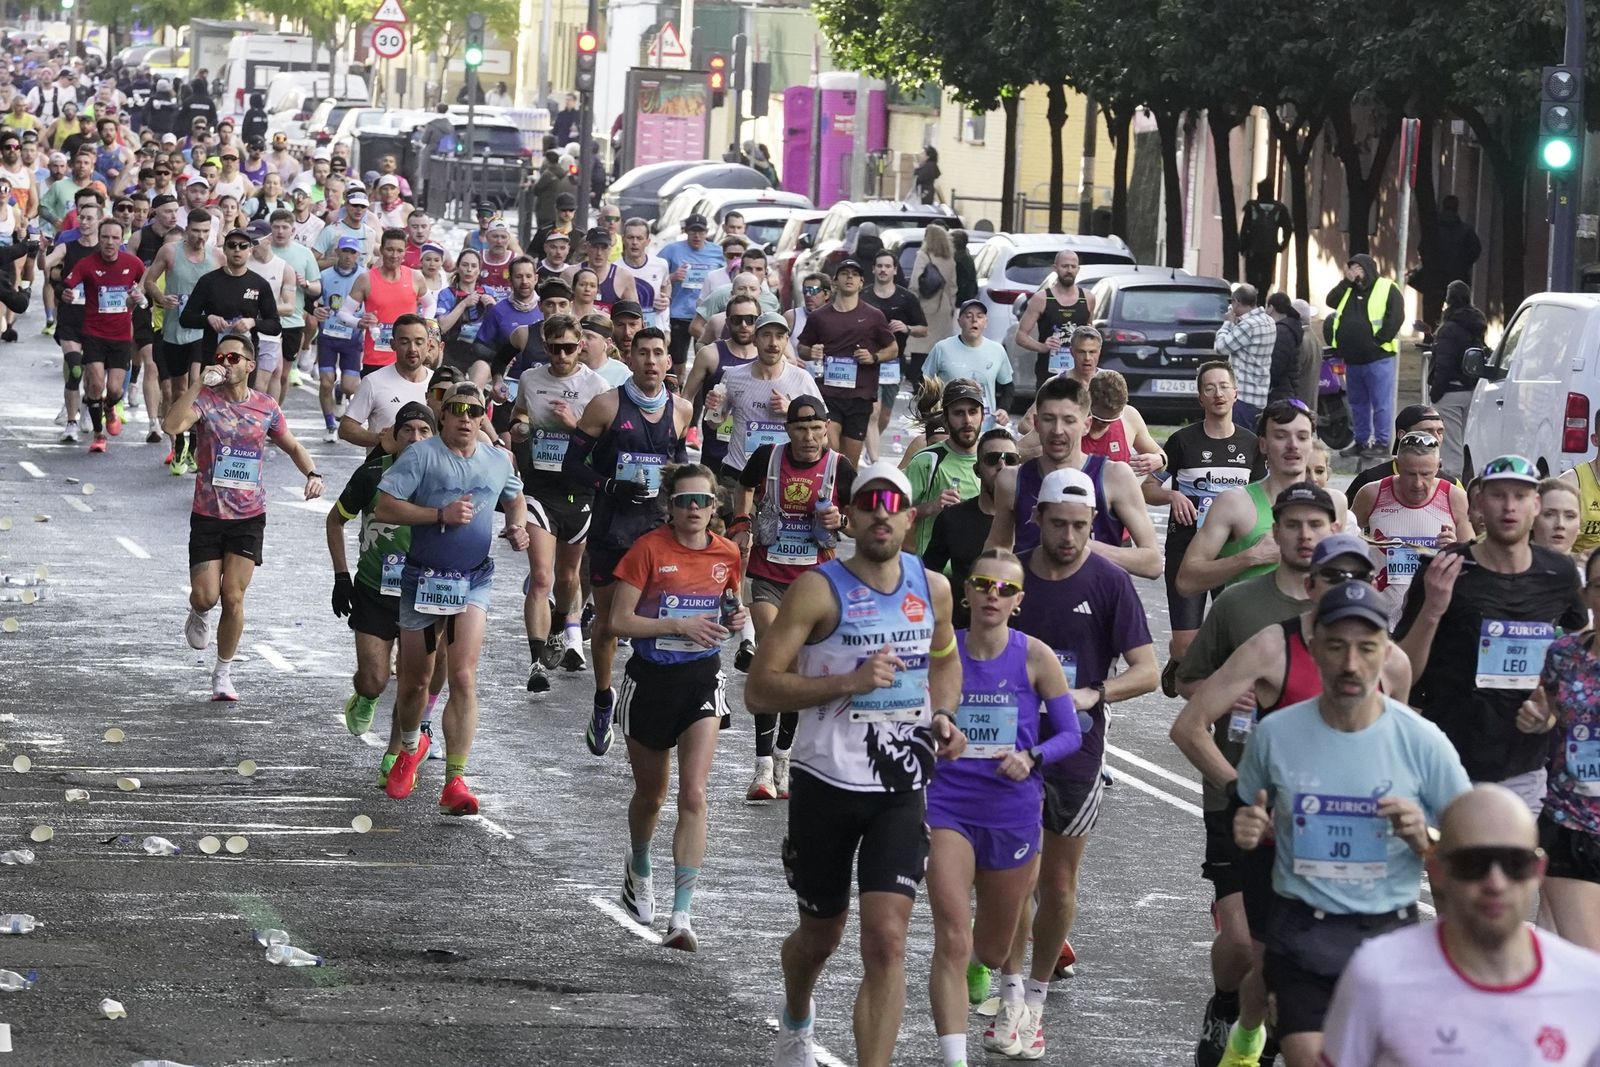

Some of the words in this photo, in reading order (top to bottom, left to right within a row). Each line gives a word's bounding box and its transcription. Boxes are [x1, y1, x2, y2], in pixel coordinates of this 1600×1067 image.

[378, 35, 400, 47] 30
[1159, 381, 1186, 391] 4249
[563, 390, 579, 398] TCE
[546, 432, 570, 440] ZURICH
[233, 449, 257, 457] ZURICH
[536, 451, 563, 462] ARNAU
[231, 461, 246, 469] 6272
[223, 468, 250, 480] SIMON
[776, 543, 809, 555] ABDOU
[420, 592, 466, 605] THIBAULT
[682, 598, 715, 607] ZURICH
[1507, 625, 1547, 636] ZURICH
[841, 633, 886, 646] MONTI
[1502, 658, 1528, 673] LEO
[967, 694, 1009, 704] ZURICH
[969, 714, 991, 724] 7342
[1325, 800, 1378, 813] ZURICH
[1326, 825, 1353, 837] 7111
[1329, 842, 1351, 859] JO
